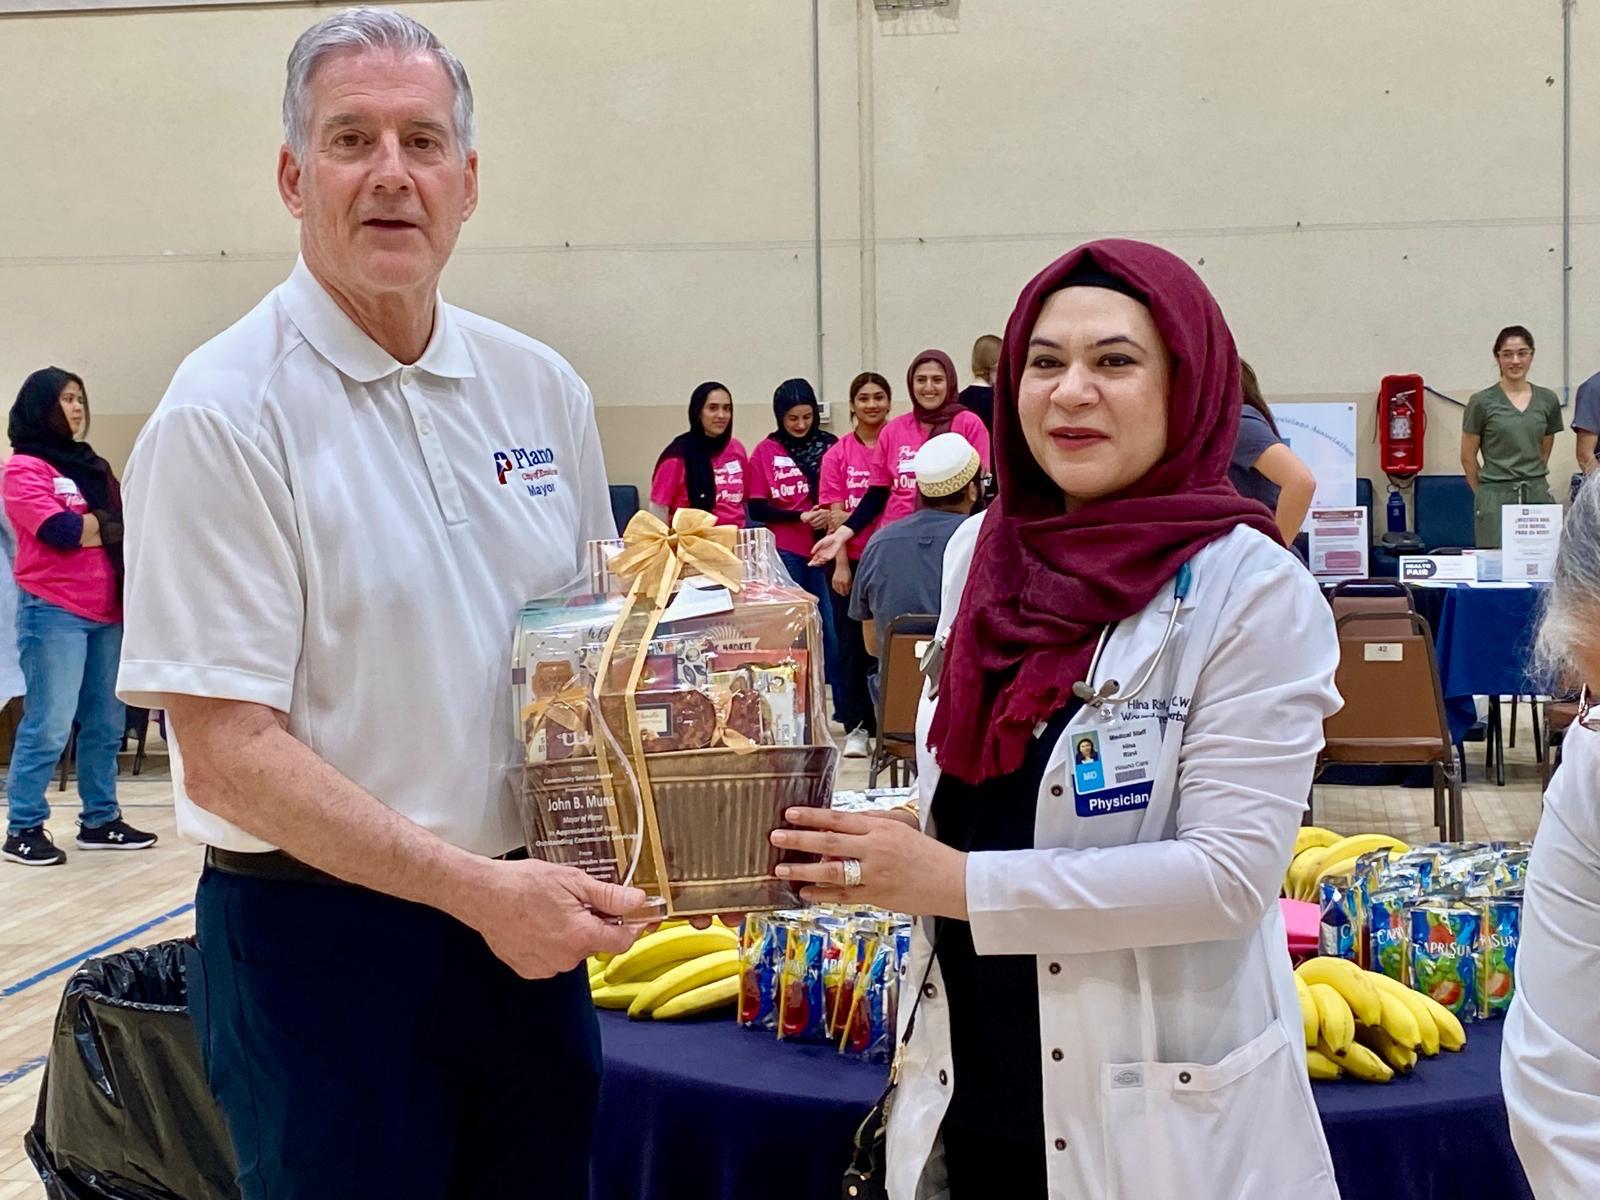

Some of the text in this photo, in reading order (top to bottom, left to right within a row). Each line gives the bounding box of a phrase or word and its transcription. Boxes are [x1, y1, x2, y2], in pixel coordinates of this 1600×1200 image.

[511, 447, 555, 470] Plano
[526, 483, 556, 497] Mayor
[780, 484, 796, 496] Our
[1406, 568, 1430, 576] FAIR
[1108, 731, 1132, 741] Medical
[1083, 770, 1097, 781] MD
[547, 794, 615, 813] John B. Muns
[1088, 792, 1150, 812] Physician
